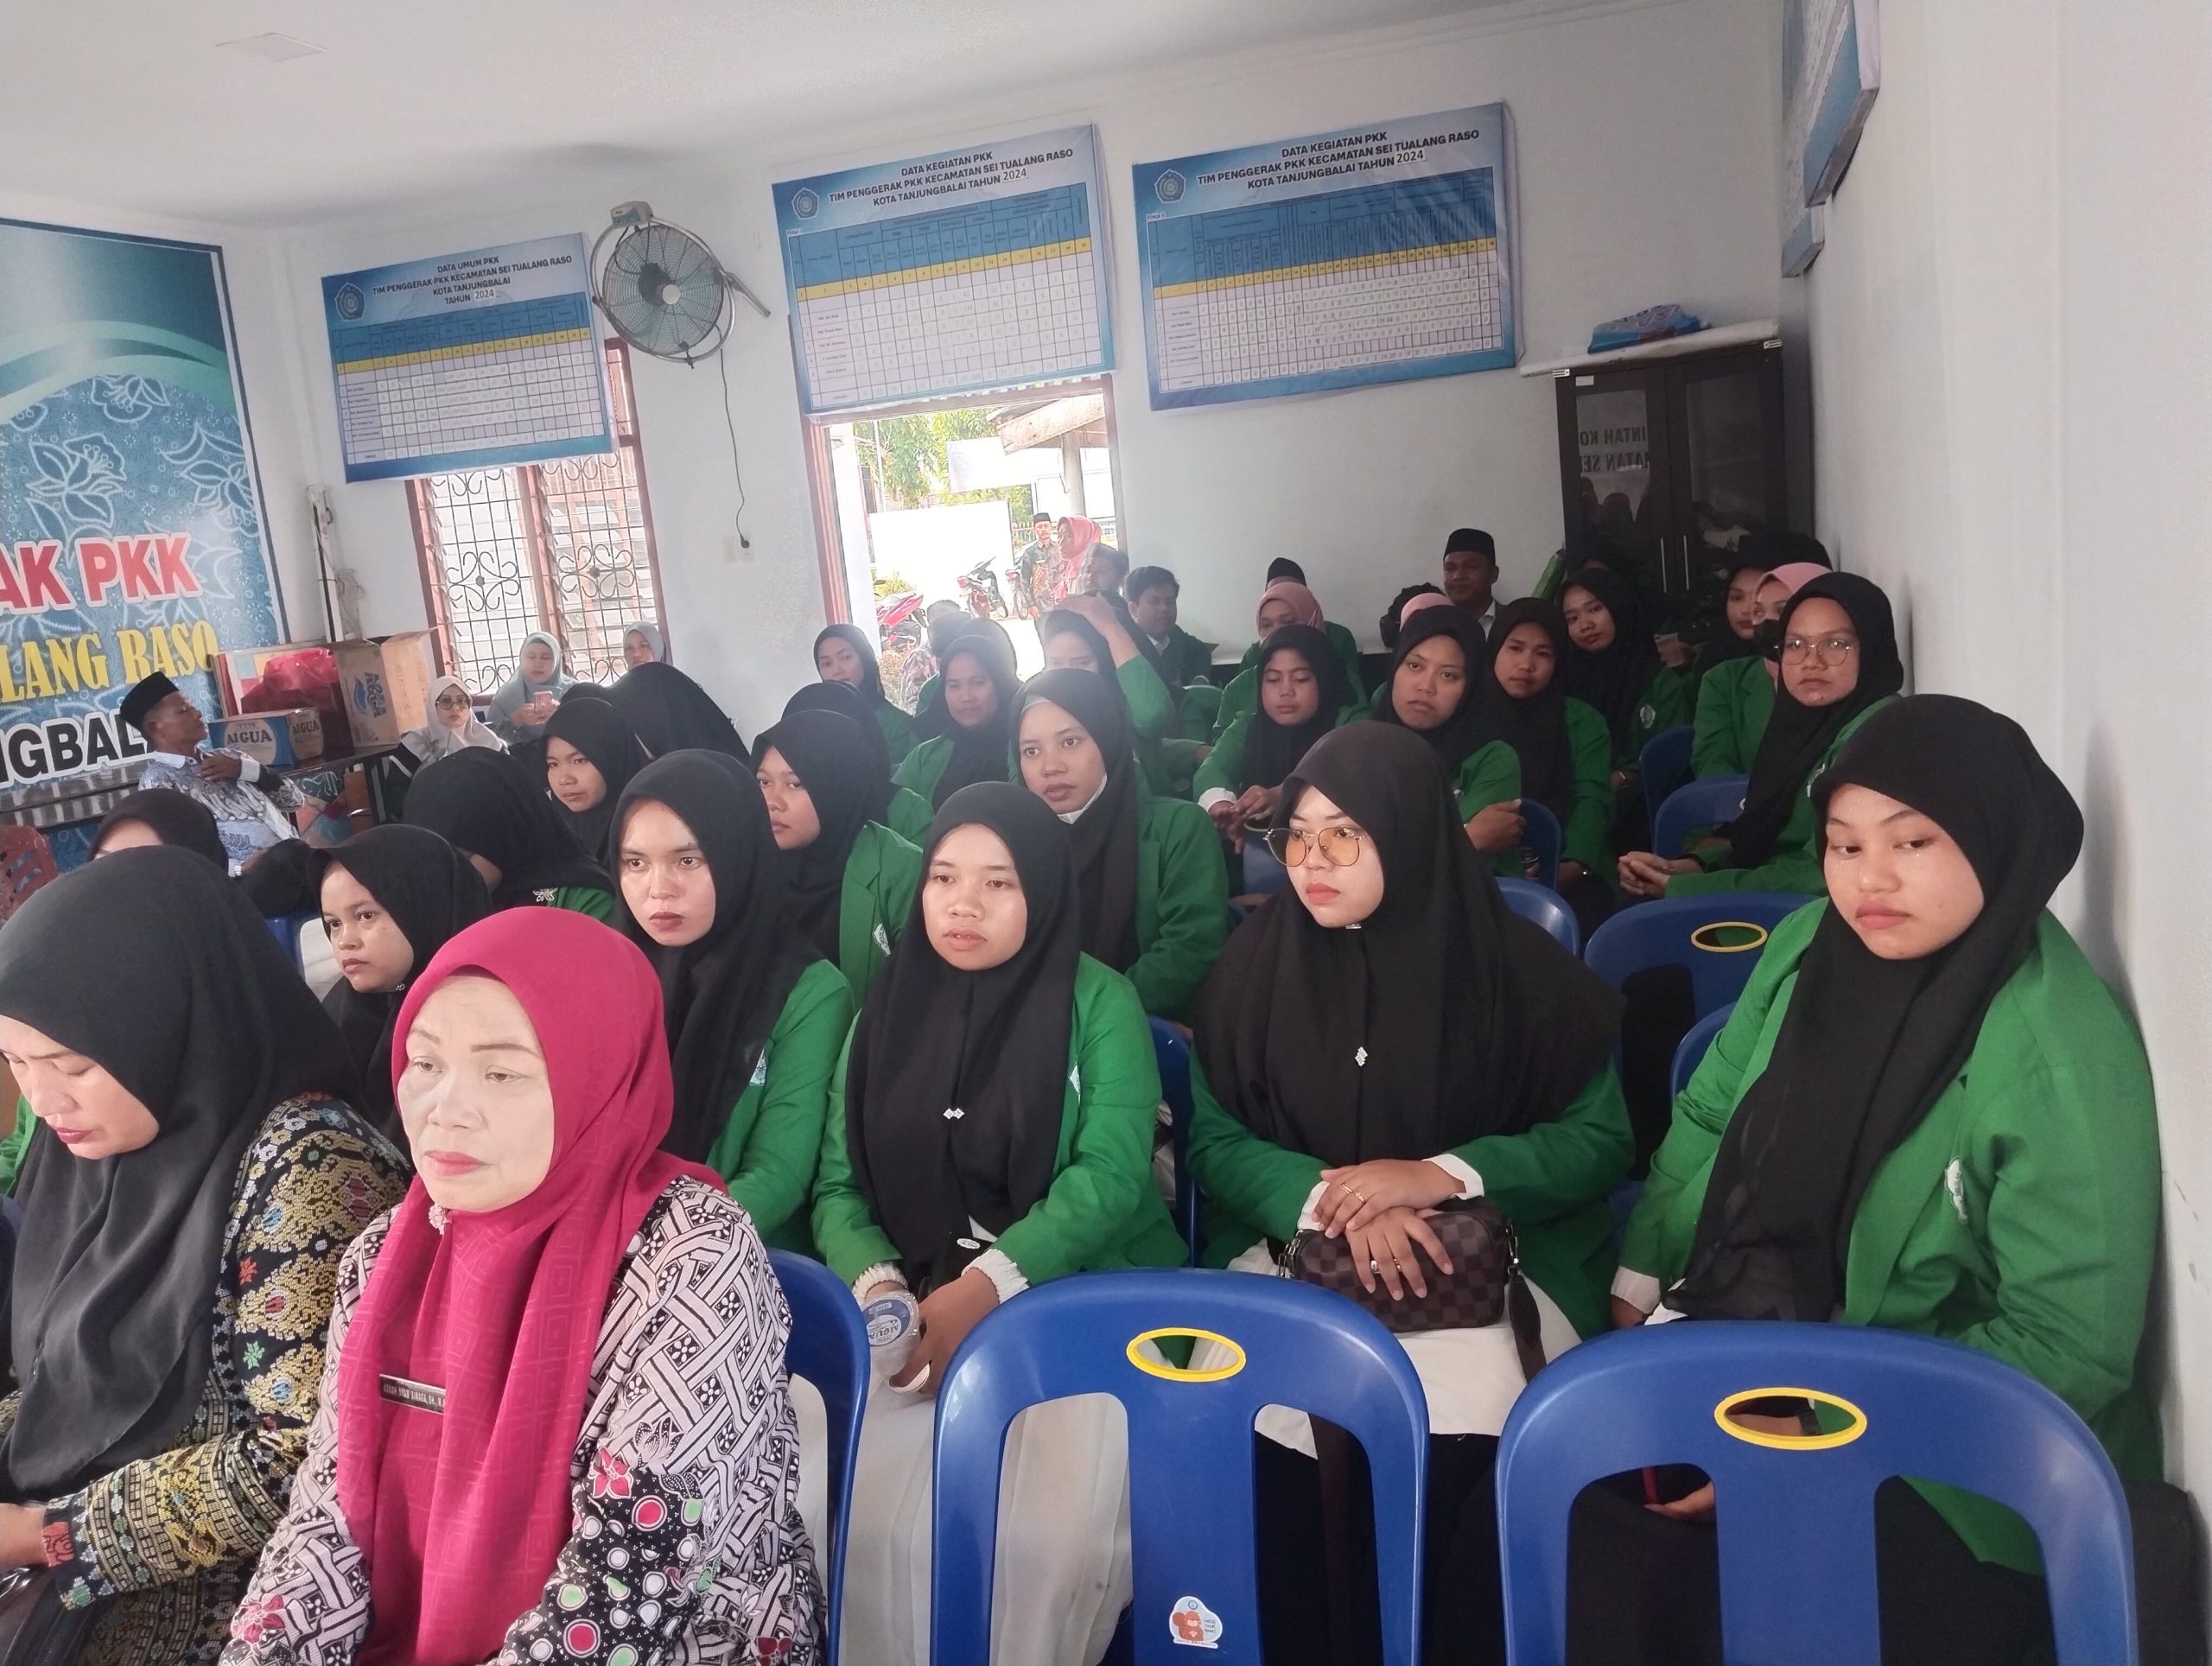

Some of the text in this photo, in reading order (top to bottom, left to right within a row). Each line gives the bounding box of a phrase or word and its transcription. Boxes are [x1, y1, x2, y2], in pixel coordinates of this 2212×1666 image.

[1198, 130, 1479, 185] TIM PENGGERAK PKK KECAMATAN SEI TUALANG RASO
[1282, 131, 1388, 157] DATA KEGIATAN PKK
[830, 149, 1073, 202] TIM PENGGERAK PKK KECAMATAN SEI TUALANG RASO
[901, 151, 993, 176] DATA KEGIATAN PKK
[1248, 149, 1424, 190] KOTA TANJUNGBALAI TAHUN 2024
[873, 169, 1027, 207] KOTA TANJUNGBALAI TAHUN 2024
[372, 256, 572, 295] TIM PENGGERAK PKK KECAMATAN SEI TUALANG RASO
[437, 256, 499, 273] DATA UMUM PKK
[433, 277, 511, 296] KOTA TANJUNGBALAI
[444, 289, 494, 304] TAHUN 2024
[79, 537, 200, 602] PKK
[116, 619, 219, 684] RASO
[227, 729, 272, 744] AIGUA
[292, 719, 320, 735] AIGUA
[0, 713, 146, 784] GBAL
